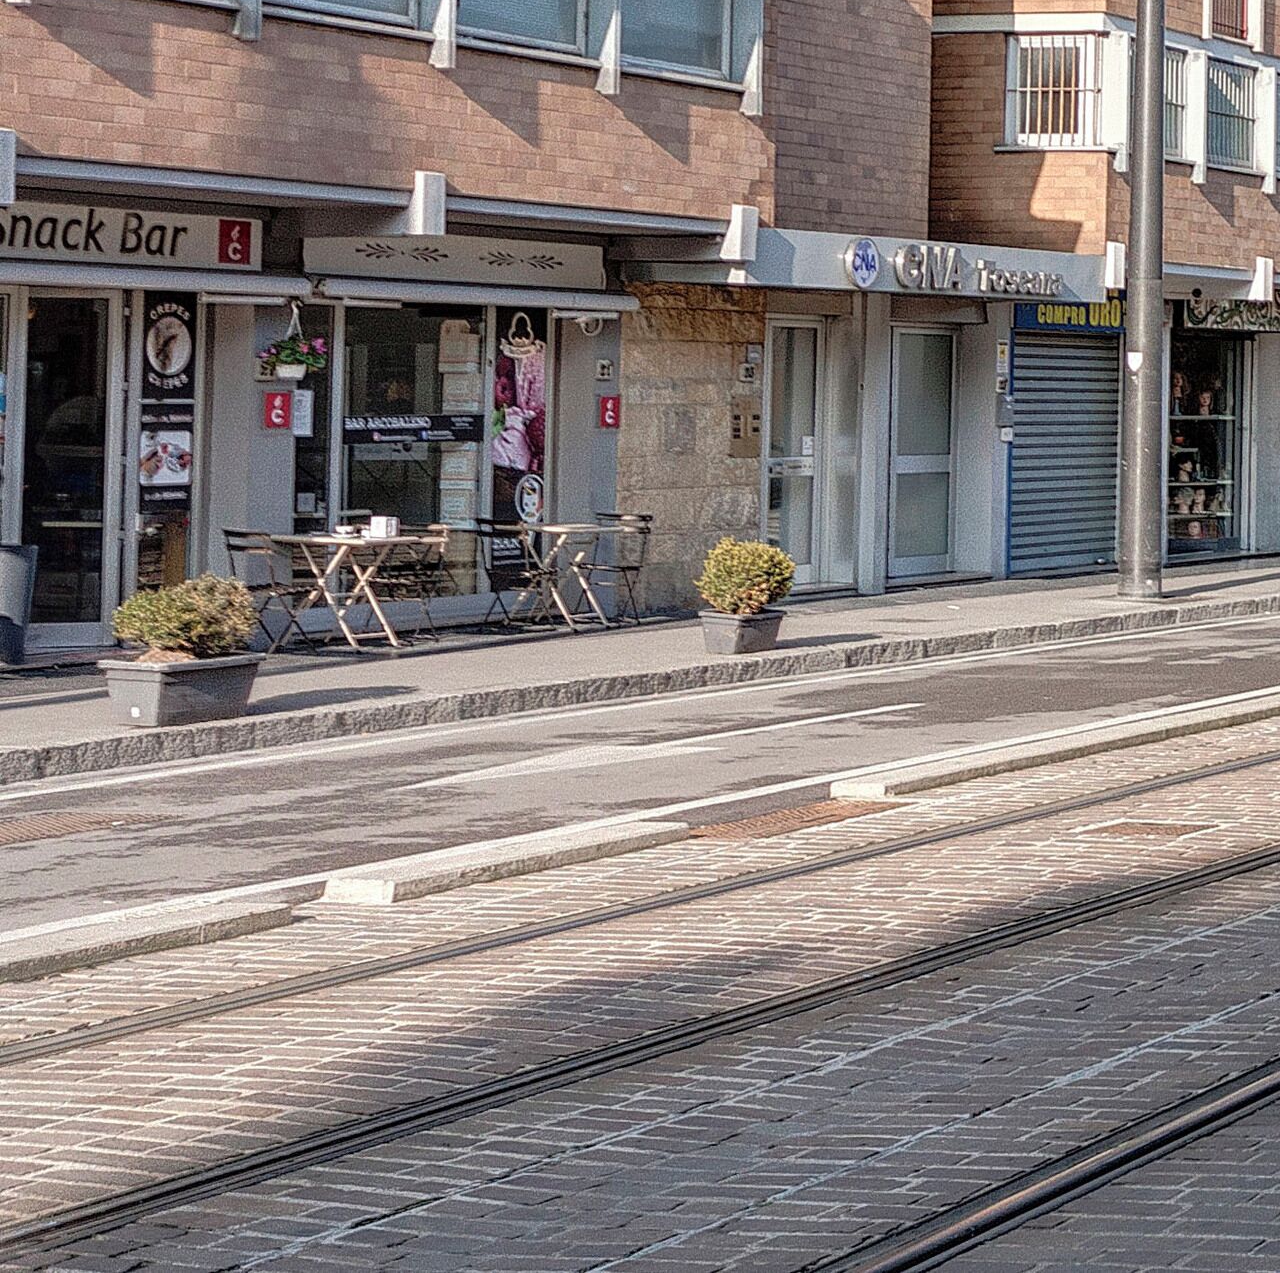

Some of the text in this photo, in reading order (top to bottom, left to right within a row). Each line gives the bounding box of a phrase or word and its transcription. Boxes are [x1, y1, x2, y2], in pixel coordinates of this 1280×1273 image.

[0, 206, 188, 257] nack Bar
[853, 252, 876, 273] CNA
[895, 244, 1063, 295] CNA Toscana
[1037, 303, 1087, 326] COMPRO
